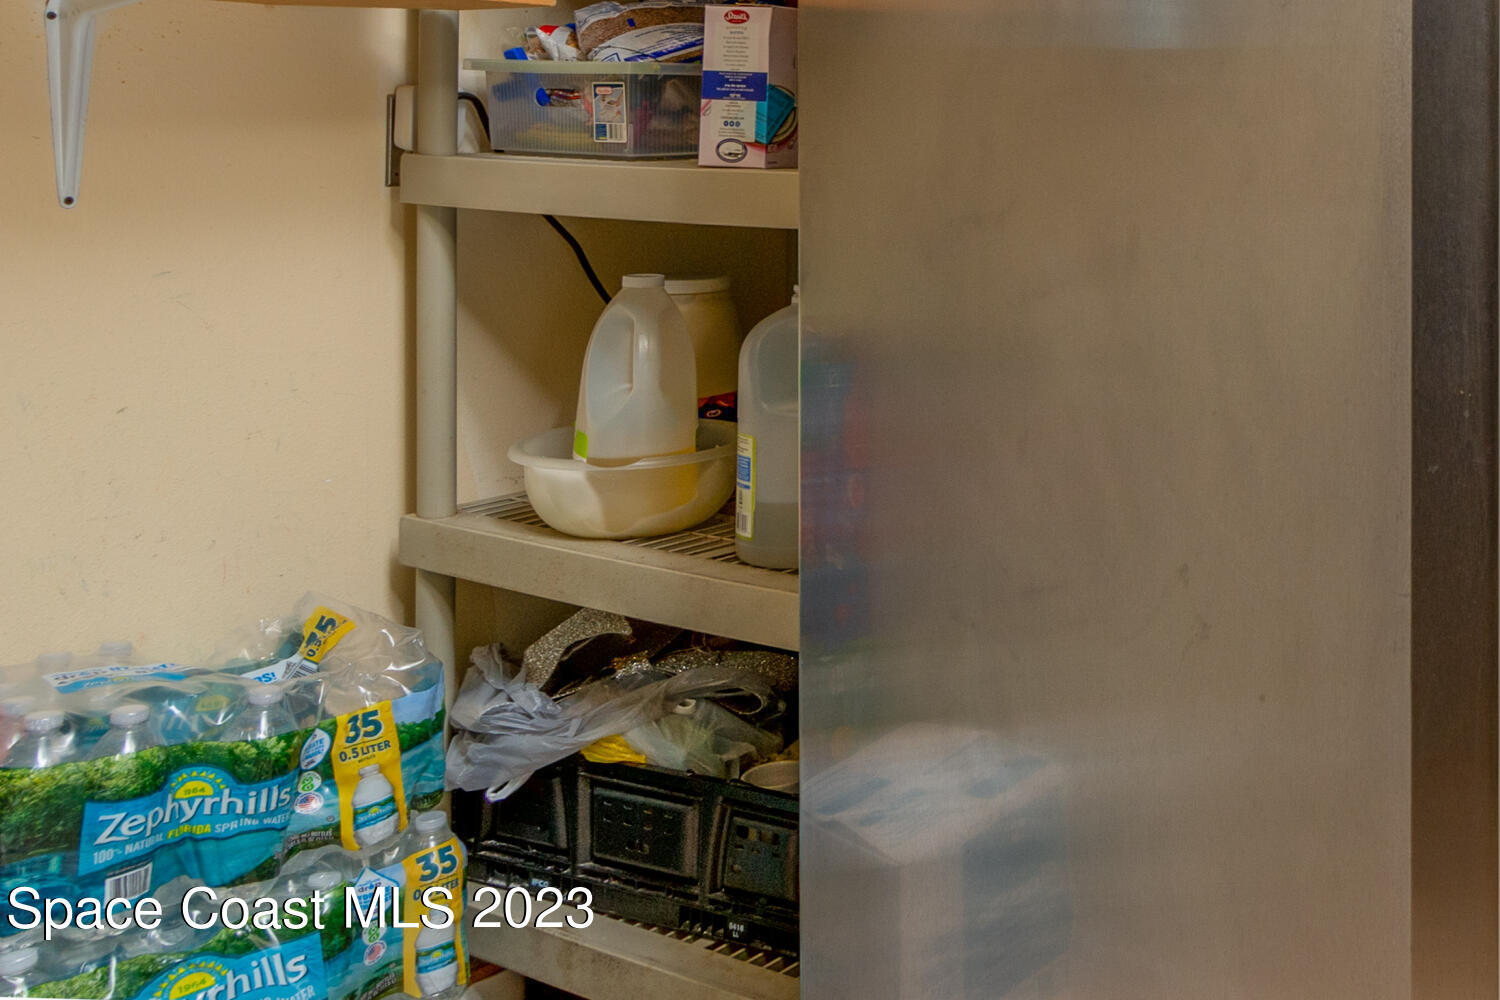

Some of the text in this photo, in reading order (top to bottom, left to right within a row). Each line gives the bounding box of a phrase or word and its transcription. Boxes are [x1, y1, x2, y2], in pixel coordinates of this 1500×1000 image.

[345, 709, 383, 744] 35
[339, 747, 360, 762] 0.5
[361, 740, 392, 757] LITER
[94, 783, 292, 846] Zephyrhills
[167, 822, 212, 840] FLORIDA
[415, 844, 459, 882] 35
